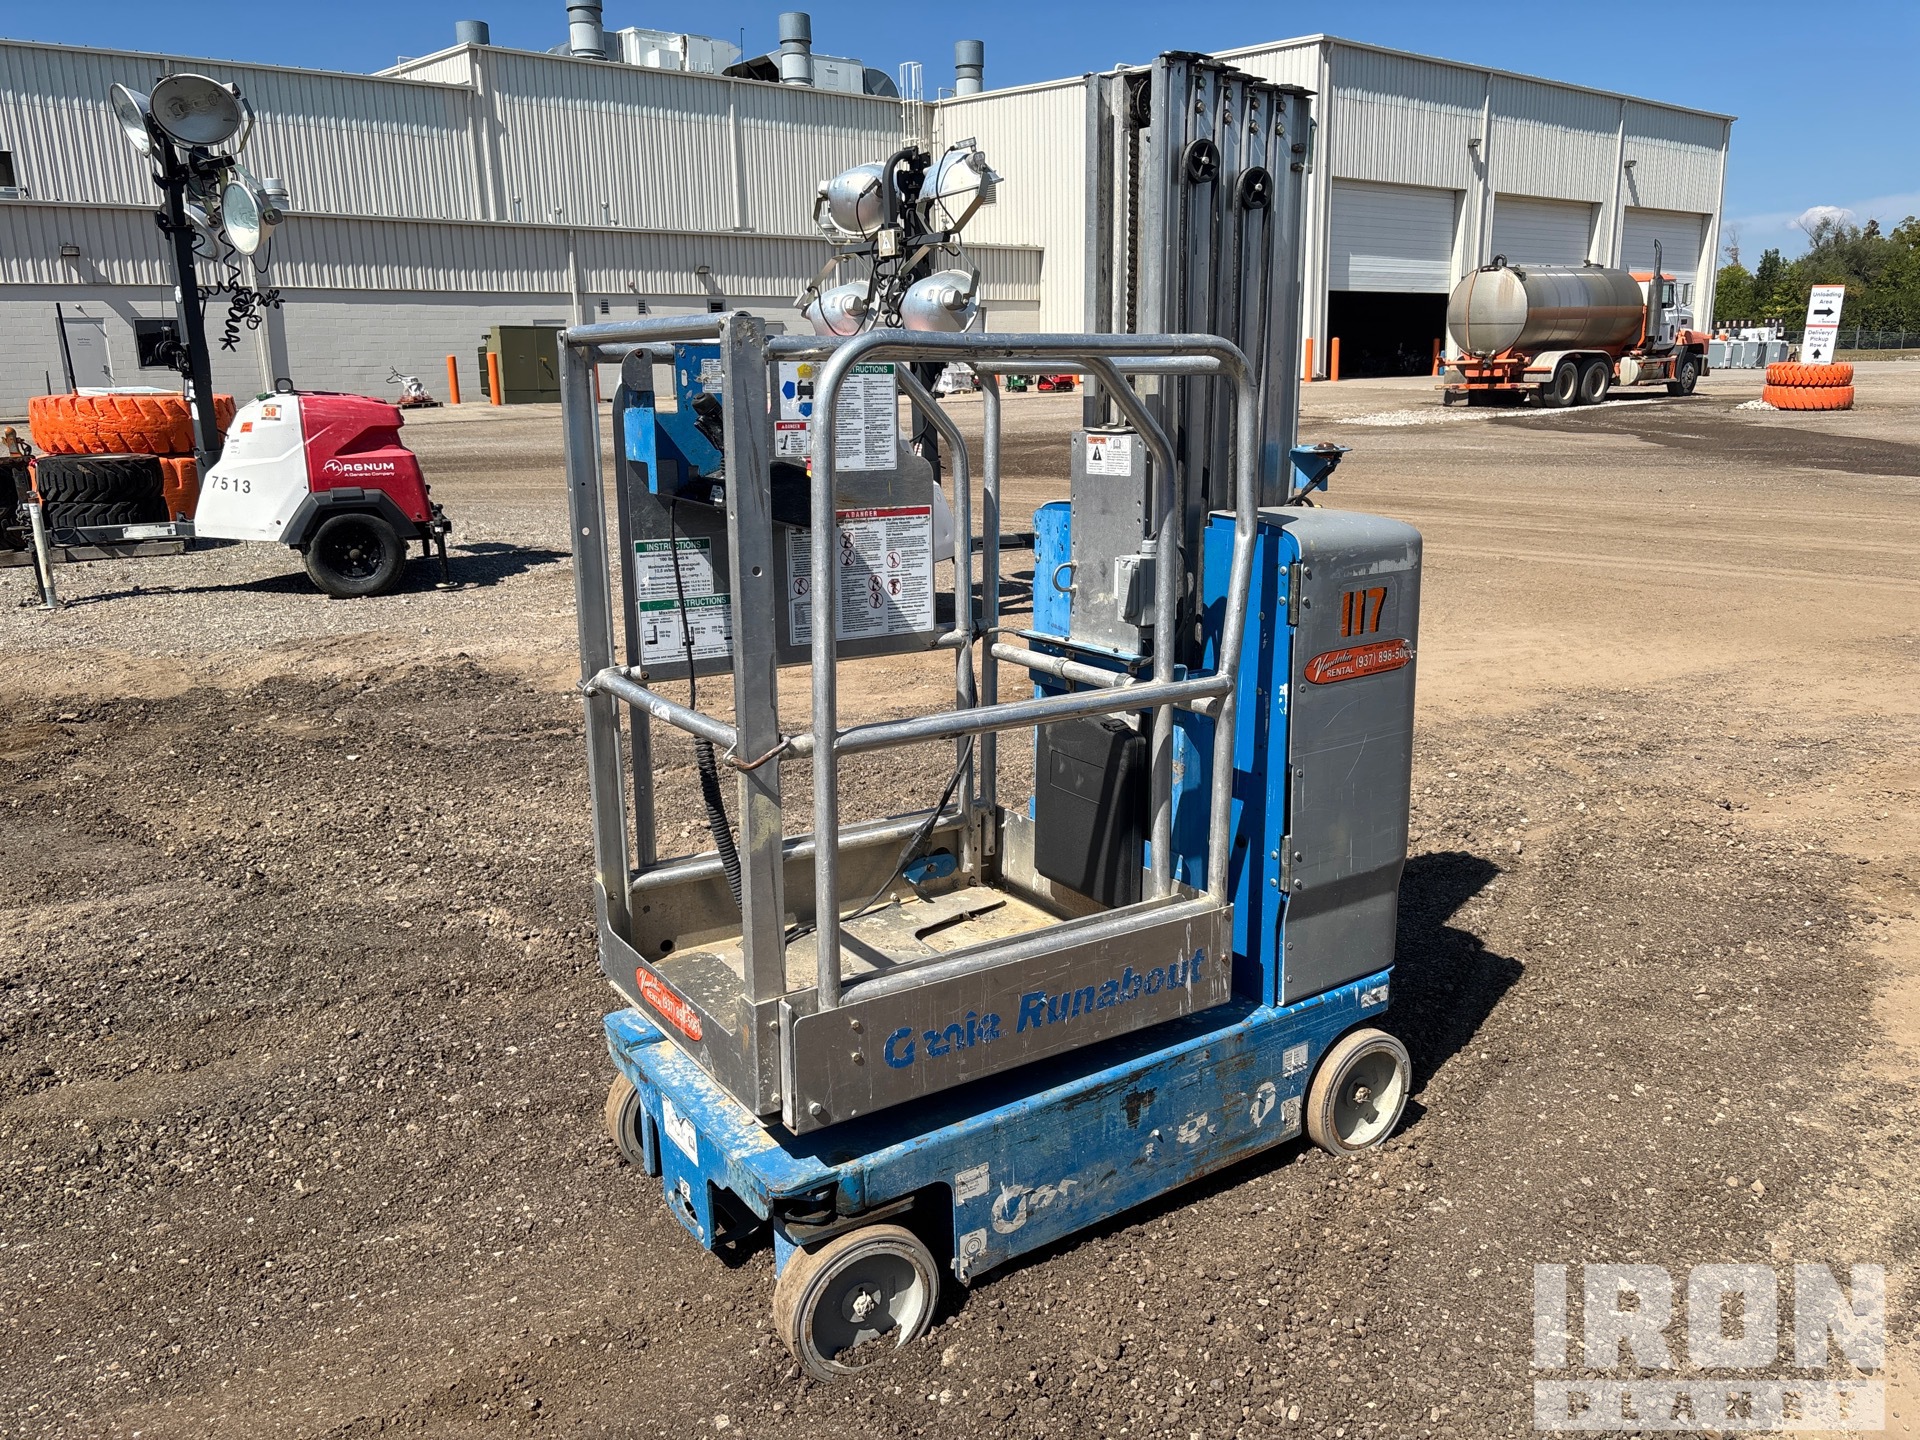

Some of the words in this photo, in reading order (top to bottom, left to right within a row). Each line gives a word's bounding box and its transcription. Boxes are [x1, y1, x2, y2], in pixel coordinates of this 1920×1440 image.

[851, 364, 888, 374] TRUCTIONS
[264, 407, 277, 417] 58
[323, 459, 395, 476] MAGNUM
[212, 475, 251, 494] 7513
[851, 510, 878, 518] DANGER
[1340, 586, 1388, 637] 117
[1355, 651, 1376, 669] (937)
[1326, 665, 1355, 678] RENTAL
[1016, 948, 1205, 1034] Runabout
